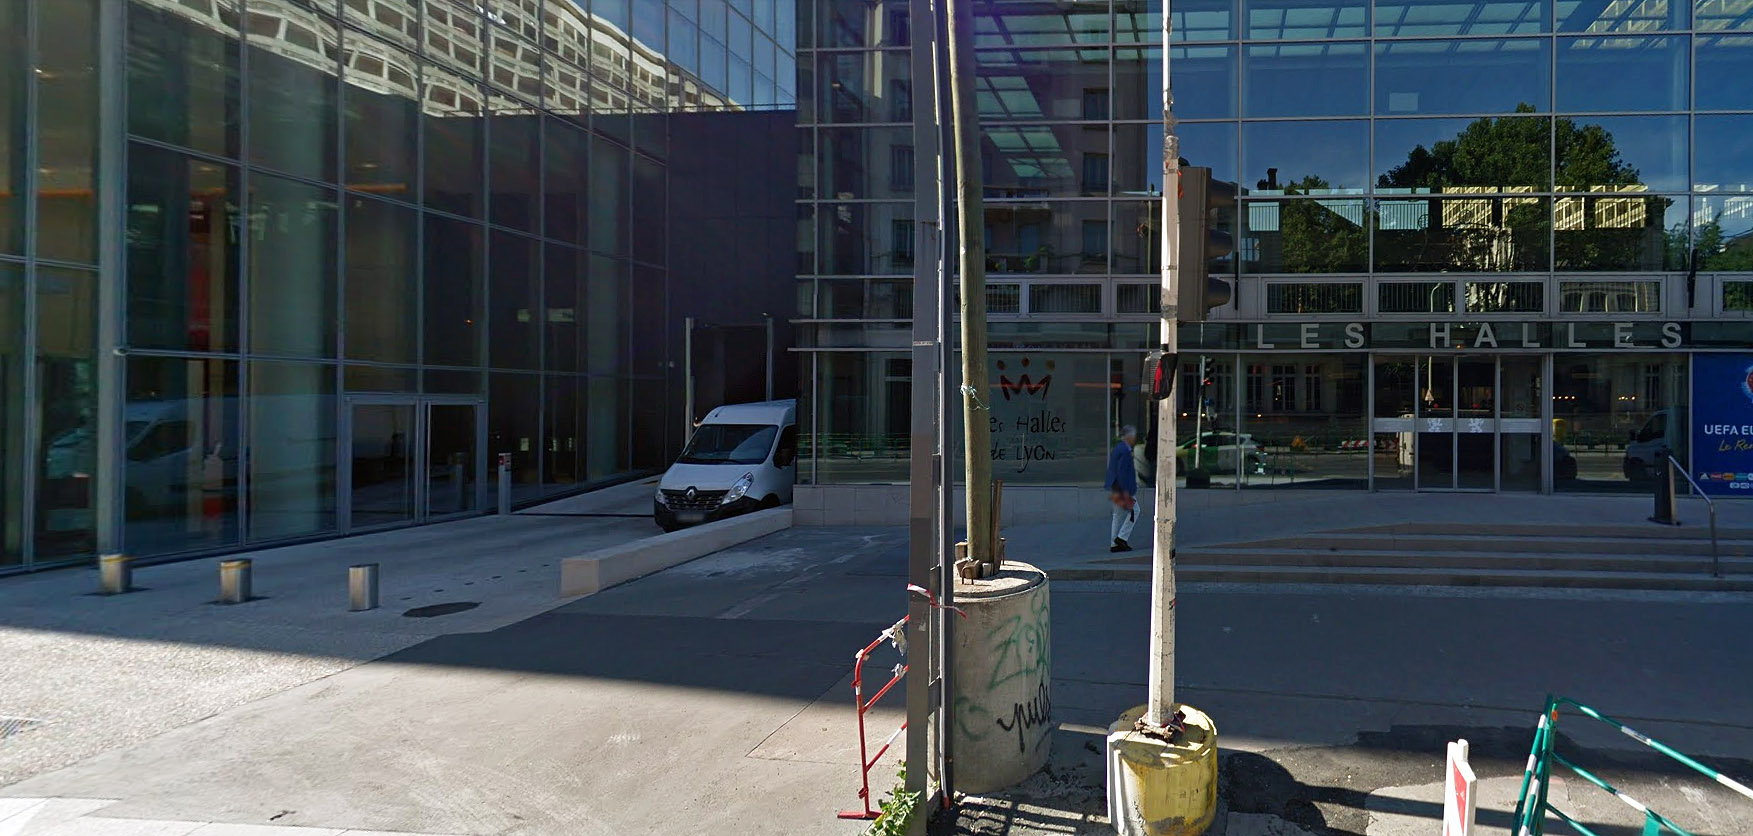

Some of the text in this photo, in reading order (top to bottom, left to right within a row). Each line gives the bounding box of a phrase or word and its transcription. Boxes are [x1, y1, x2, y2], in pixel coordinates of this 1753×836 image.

[1257, 321, 1682, 349] LES HALLES
[989, 409, 1066, 434] es Halles
[1704, 424, 1739, 435] UEFA
